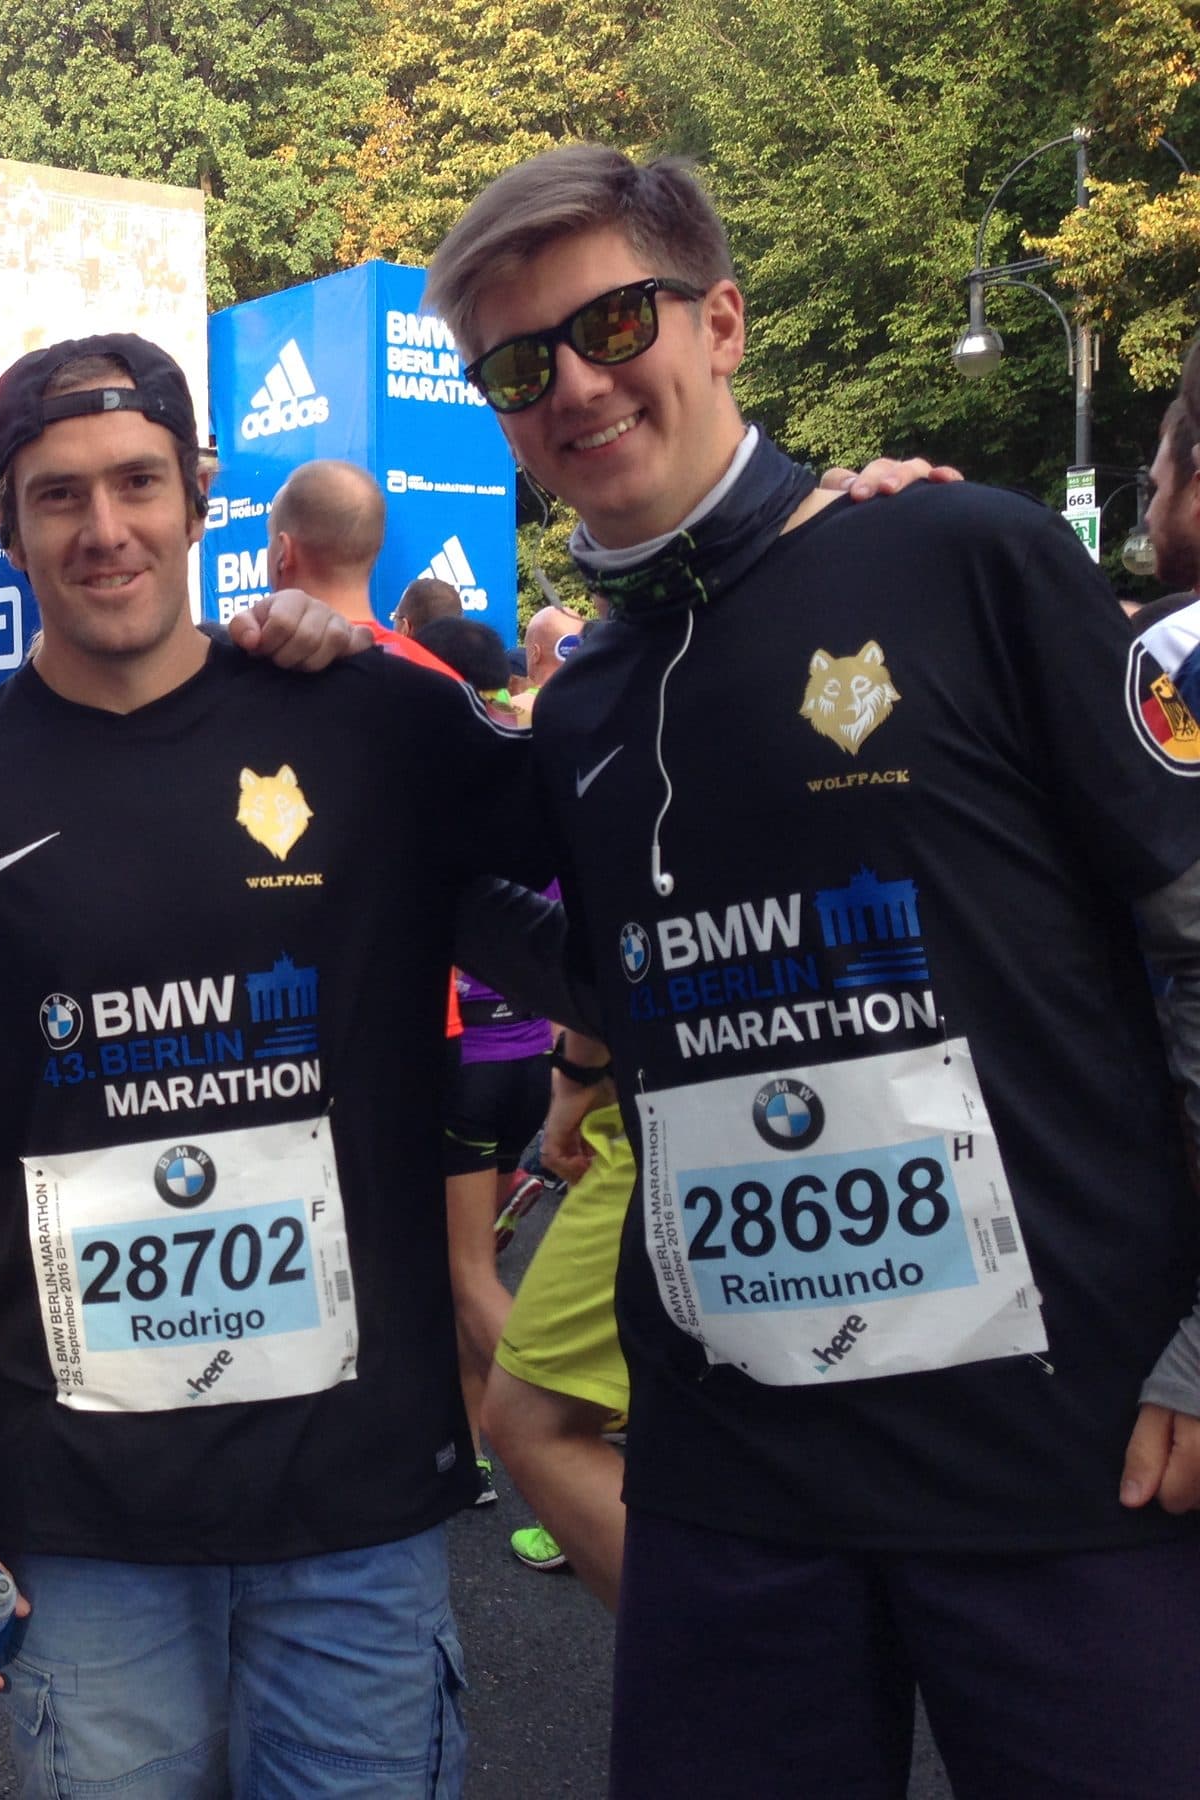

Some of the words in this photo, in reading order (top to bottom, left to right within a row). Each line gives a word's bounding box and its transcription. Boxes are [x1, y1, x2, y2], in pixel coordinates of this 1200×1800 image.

[386, 311, 456, 349] BMW
[387, 346, 460, 378] BERLIN
[387, 374, 488, 408] MARATHO
[241, 396, 330, 440] adidas
[230, 503, 265, 519] WORLD
[1068, 493, 1093, 506] 663
[217, 548, 269, 594] BM
[806, 769, 910, 793] WOLFPACK
[245, 873, 324, 889] WOLFPACK
[657, 892, 801, 971] BMW
[668, 954, 820, 1013] BERLIN
[91, 974, 236, 1039] BMW
[675, 990, 938, 1060] MARATHON
[43, 1051, 97, 1088] 43.
[100, 1028, 244, 1077] BERLIN
[104, 1058, 321, 1118] MARATHON
[757, 1080, 815, 1107] BMW
[158, 1146, 210, 1170] BMW
[954, 1134, 975, 1163] H
[311, 1200, 325, 1223] F
[649, 1120, 676, 1284] BERLIN-MARATHON
[684, 1156, 951, 1262] 28698
[664, 1211, 678, 1247] 2016
[35, 1183, 63, 1326] BERLIN-MARATHON
[80, 1216, 306, 1306] 28702
[60, 1262, 71, 1293] 2016
[673, 1248, 699, 1327] September
[720, 1257, 925, 1306] Raimundo
[130, 1308, 266, 1343] Rodrigo
[668, 1284, 688, 1326] BMW
[56, 1327, 69, 1363] BMW
[63, 1292, 81, 1367] September
[814, 1312, 868, 1367] here
[71, 1366, 84, 1387] 25.
[186, 1348, 234, 1394] here
